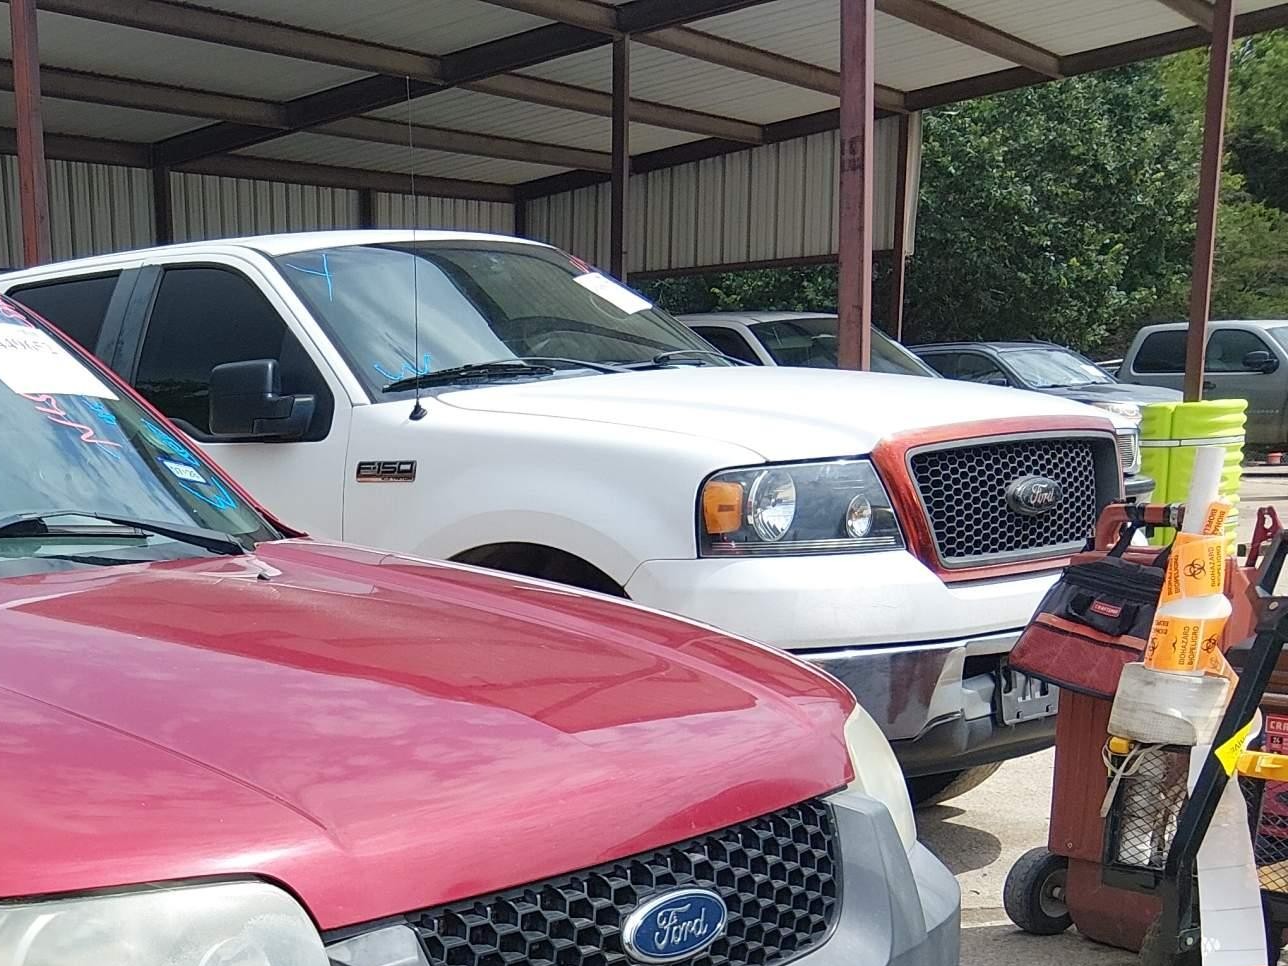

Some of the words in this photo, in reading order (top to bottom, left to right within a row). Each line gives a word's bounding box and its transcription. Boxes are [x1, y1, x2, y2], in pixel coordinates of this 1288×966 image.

[1030, 483, 1055, 505] Ford
[1178, 626, 1190, 666] BIOHAZARD
[1187, 625, 1200, 666] BIOPELIGRO
[654, 903, 709, 951] Ford
